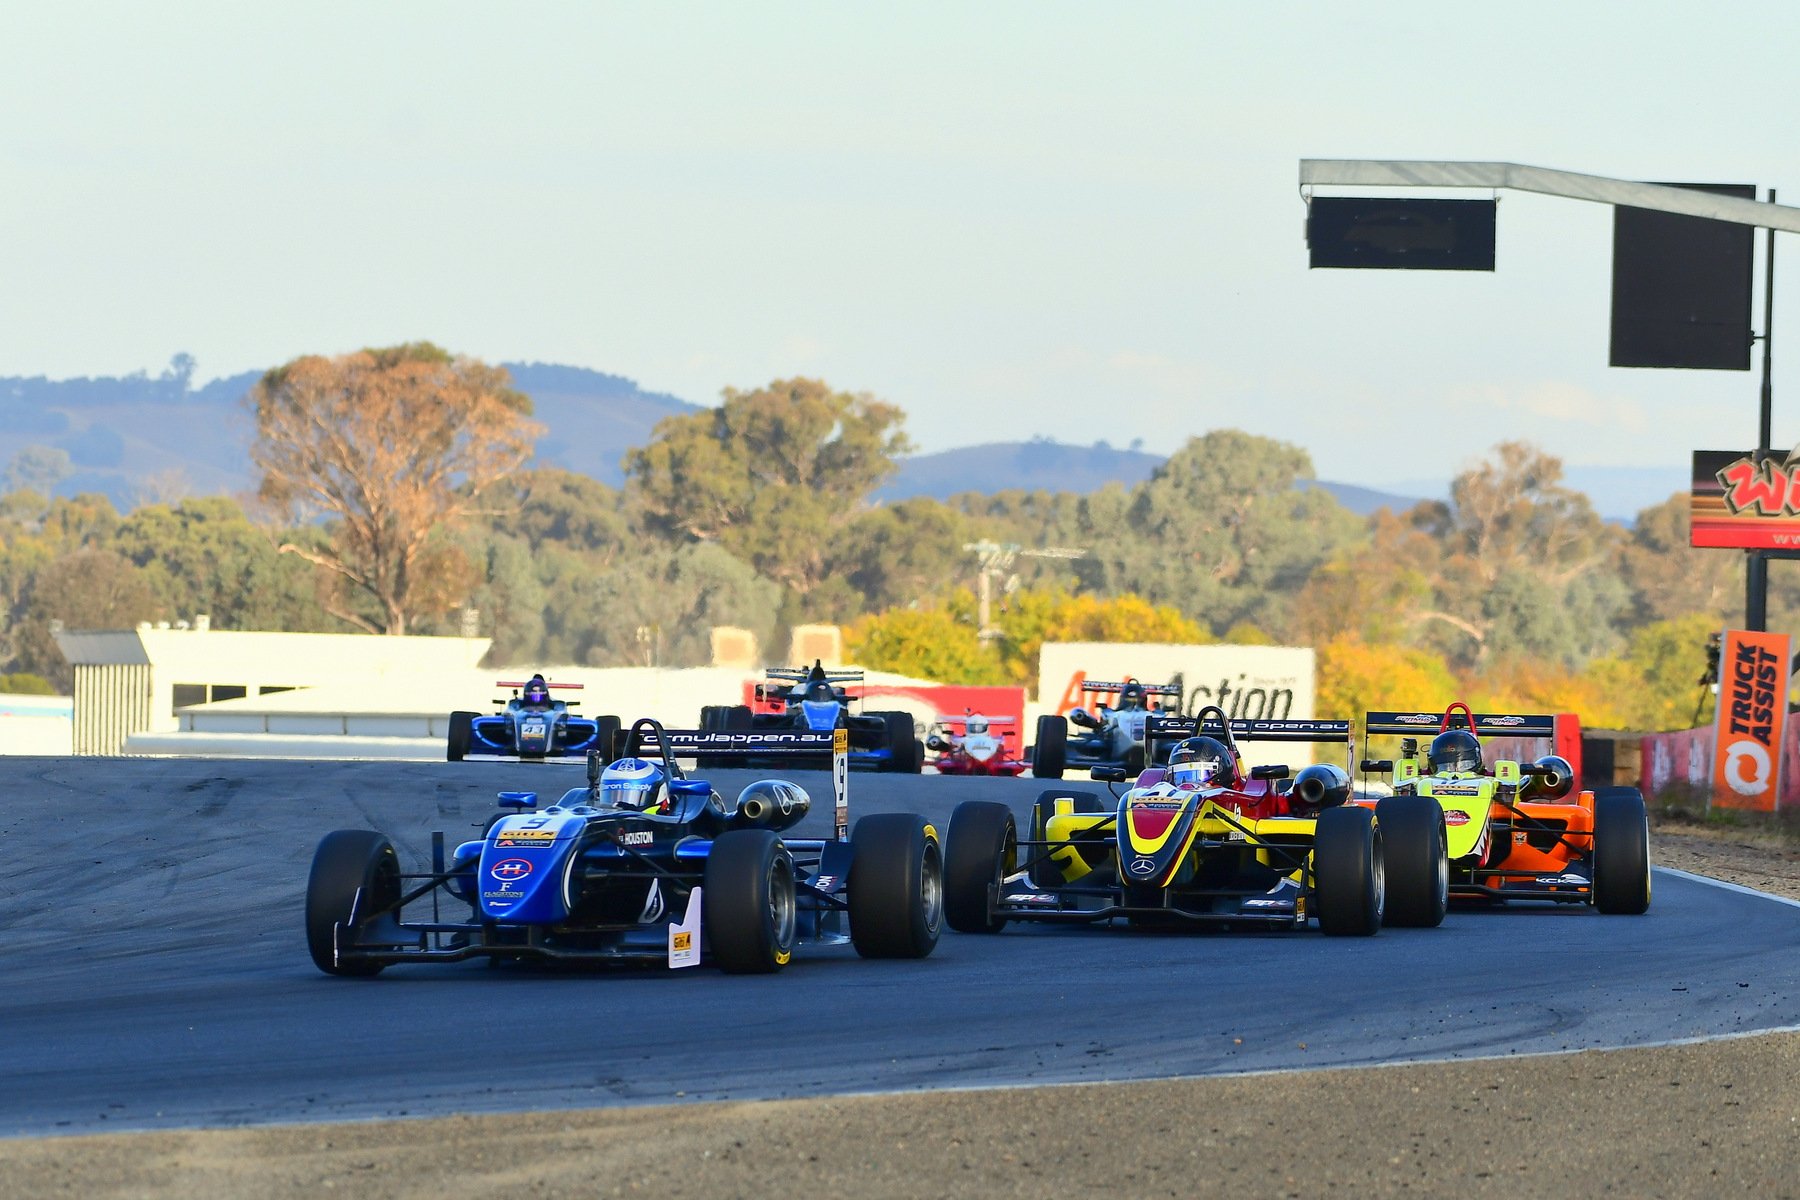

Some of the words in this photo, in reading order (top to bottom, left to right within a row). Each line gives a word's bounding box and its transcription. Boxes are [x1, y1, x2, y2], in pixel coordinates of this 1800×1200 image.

[1730, 641, 1757, 735] TRUCK
[1752, 647, 1777, 747] ASSIST
[625, 831, 653, 845] HOUSTON
